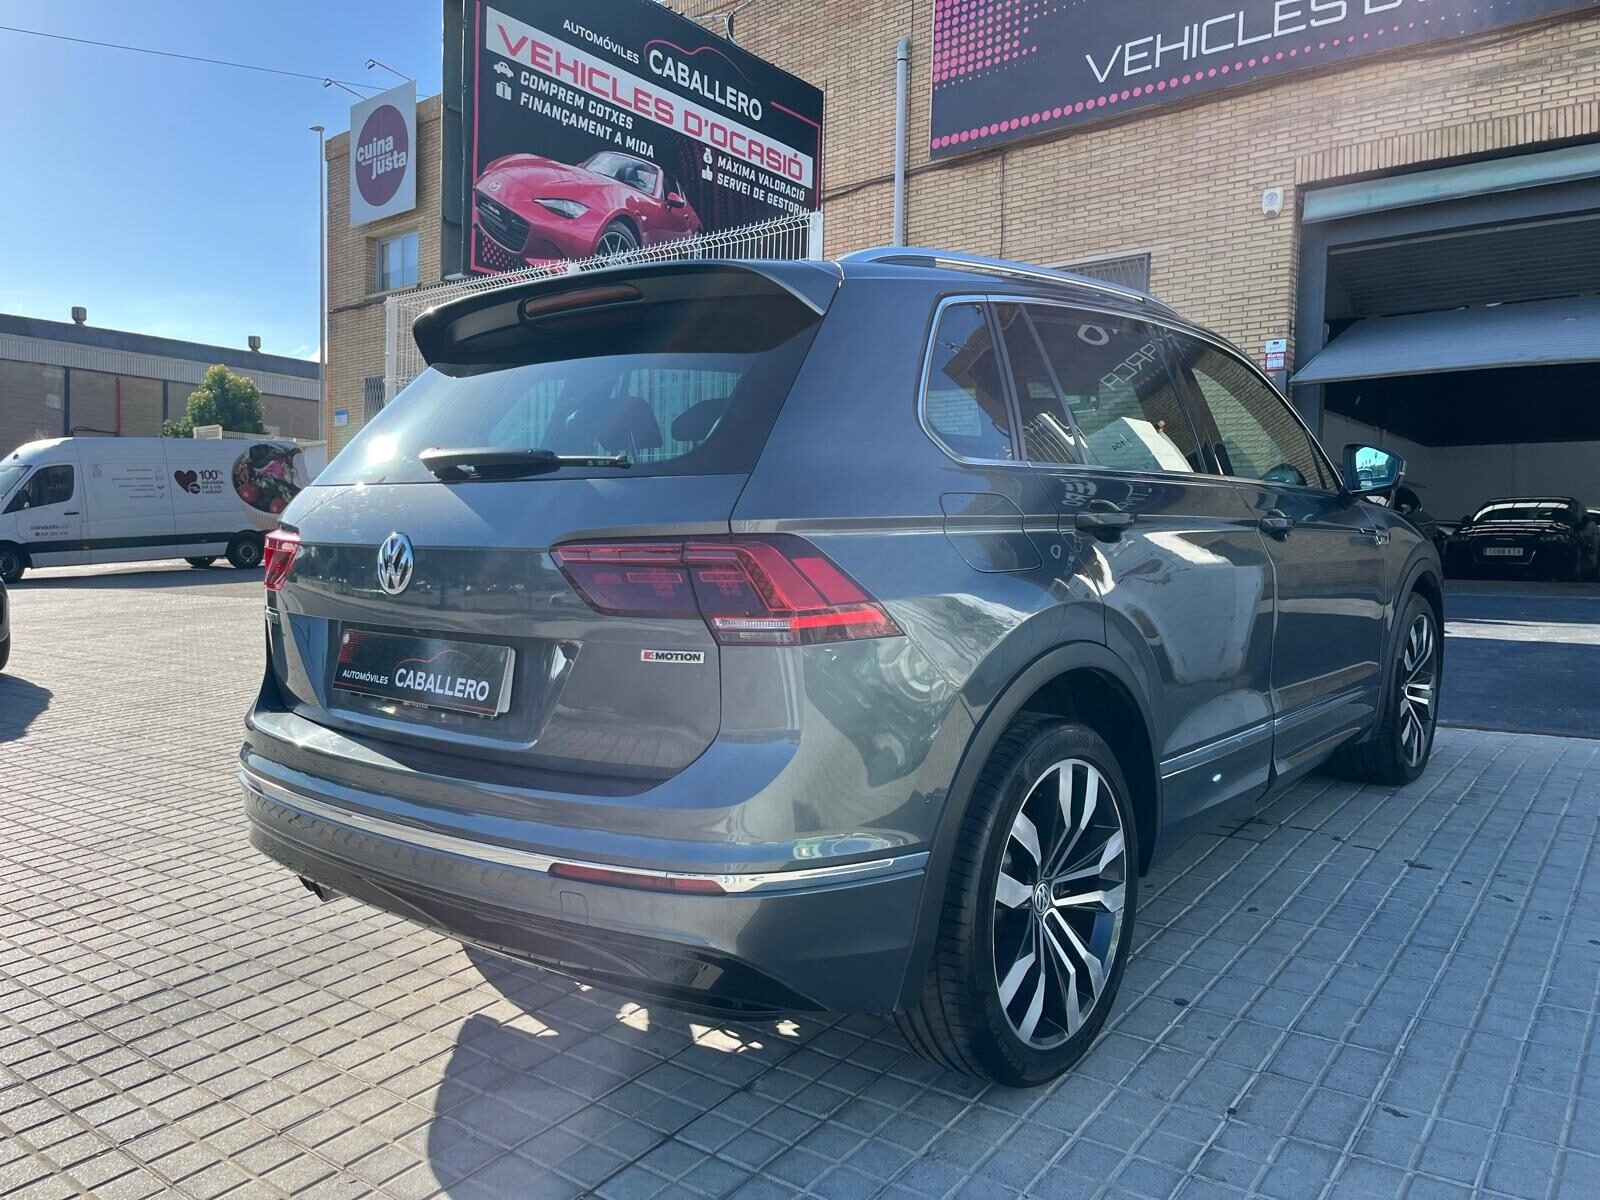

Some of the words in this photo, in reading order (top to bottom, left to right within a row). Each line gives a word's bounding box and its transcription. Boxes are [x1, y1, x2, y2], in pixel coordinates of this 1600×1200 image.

[563, 19, 640, 64] AUTOMÓVILES
[1085, 0, 1347, 83] VEHICLES
[497, 23, 674, 125] VEHICLES
[683, 109, 803, 181] D'OCASIÓ
[520, 71, 585, 110] COMPREM
[588, 100, 633, 130] COTXES
[649, 49, 762, 121] CABALLERO
[520, 92, 613, 140] FINANÇAMENT
[614, 131, 622, 145] A
[625, 135, 654, 158] MIDA
[356, 135, 394, 163] cuina
[371, 150, 407, 180] justa
[717, 155, 756, 182] MÀXIMA
[758, 172, 805, 202] VALORACIÓ
[717, 173, 751, 196] SERVEI
[752, 187, 765, 201] DE
[342, 669, 389, 685] AUTOMÓVILES
[395, 668, 490, 701] CABALLERO
